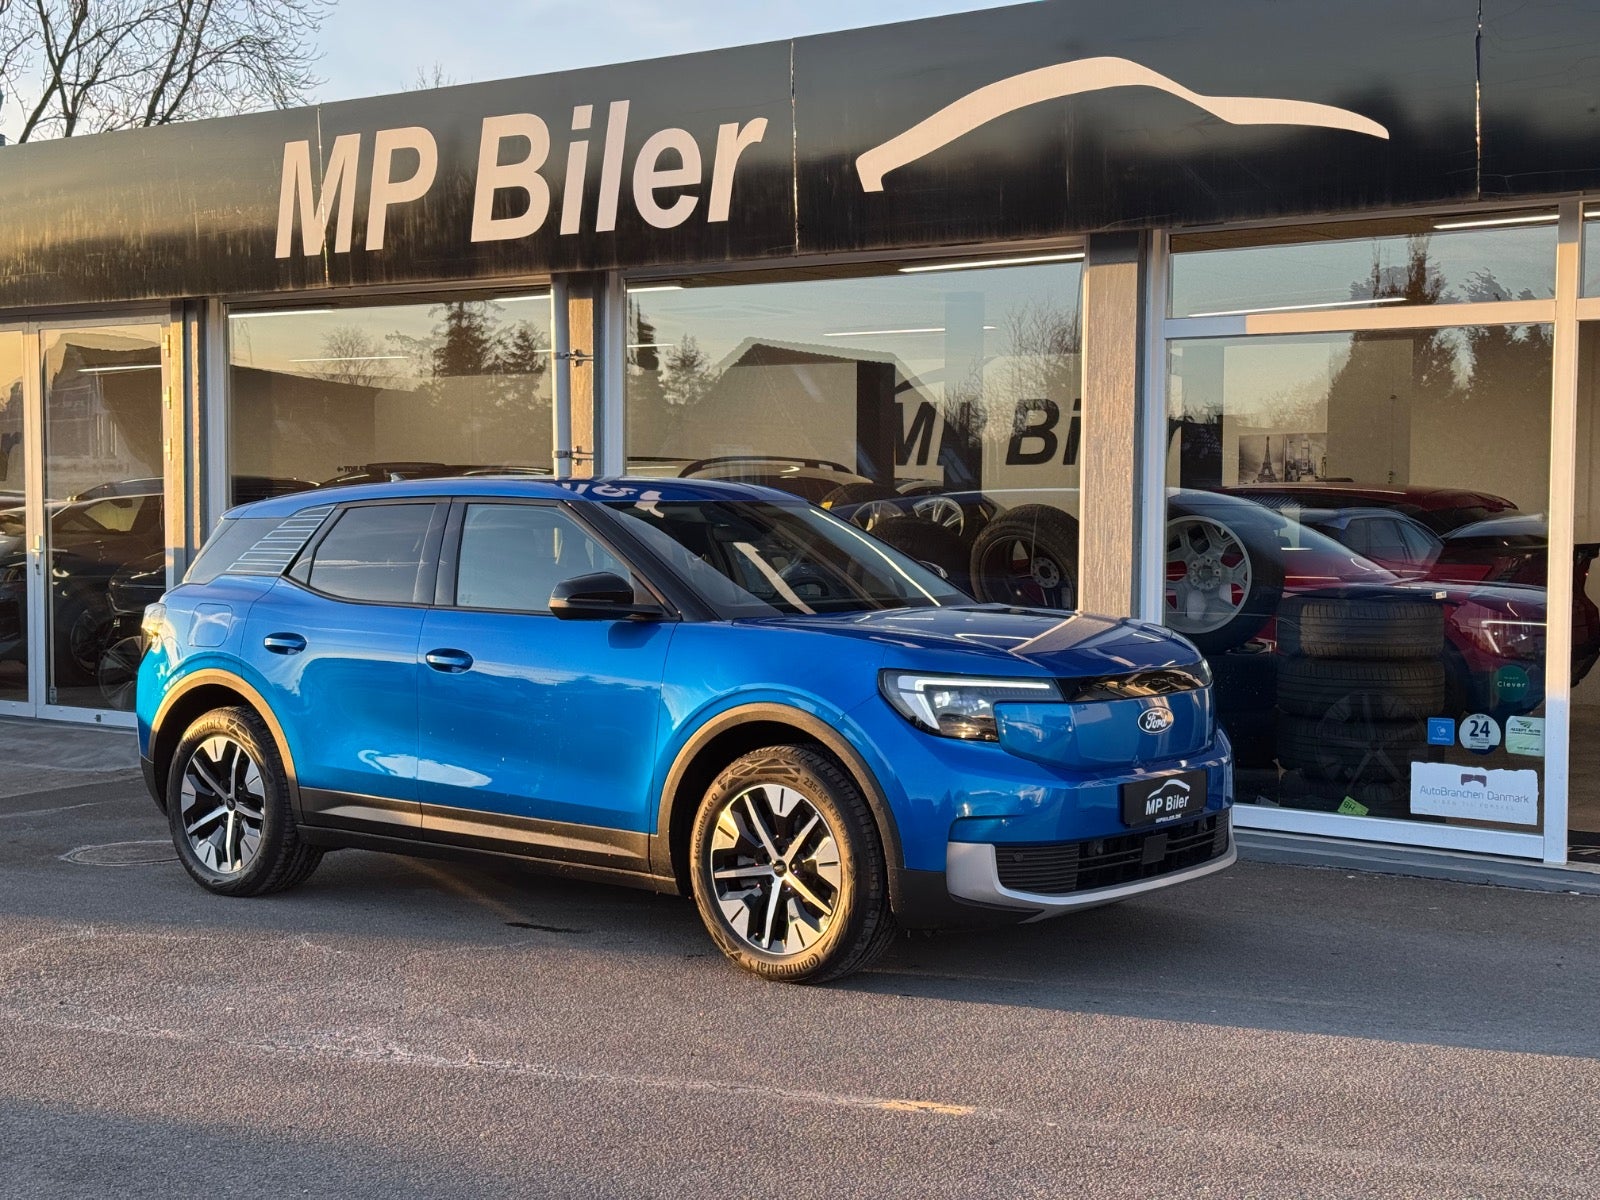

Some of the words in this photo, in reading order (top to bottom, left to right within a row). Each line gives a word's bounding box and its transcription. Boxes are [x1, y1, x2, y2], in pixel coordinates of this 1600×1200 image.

[275, 126, 438, 259] MP
[470, 99, 768, 243] Biler
[1497, 680, 1526, 688] Clever
[1145, 711, 1168, 730] Ford
[1469, 719, 1491, 738] 24
[1419, 785, 1484, 799] AutoBranchen
[1487, 790, 1529, 803] Danmark
[1145, 799, 1163, 816] MP
[1166, 795, 1190, 813] Biler
[756, 953, 821, 975] Continental
